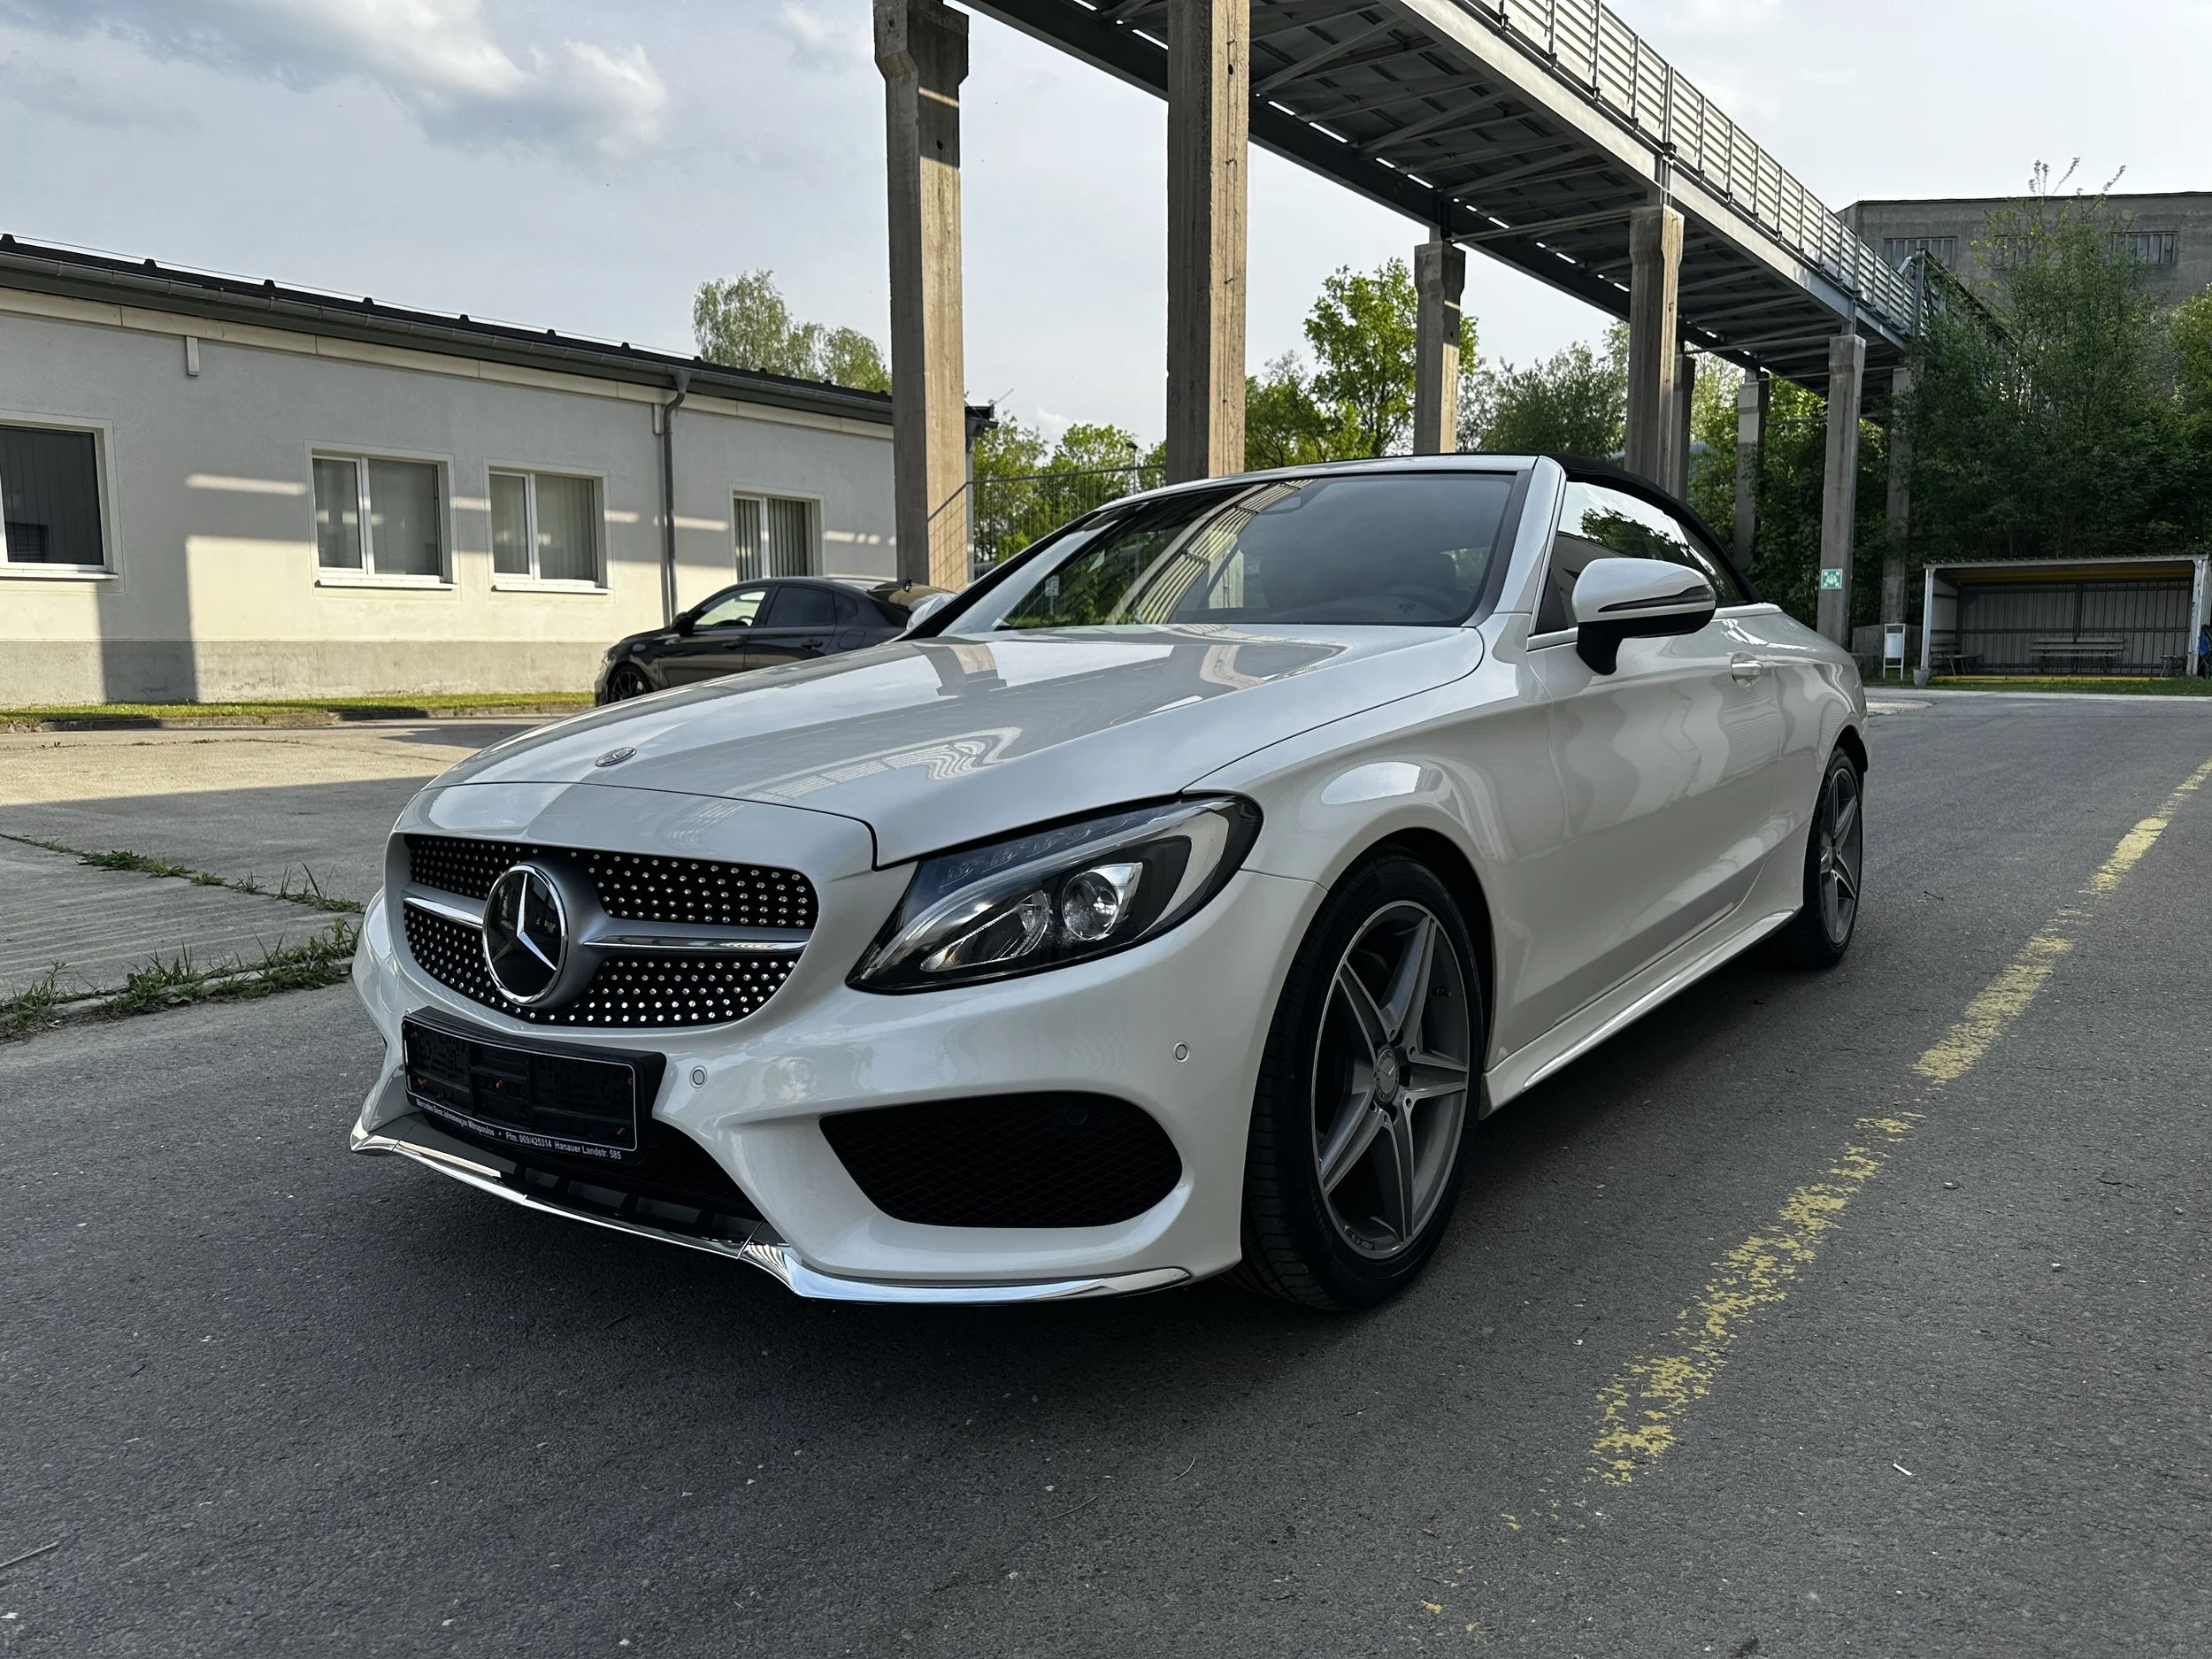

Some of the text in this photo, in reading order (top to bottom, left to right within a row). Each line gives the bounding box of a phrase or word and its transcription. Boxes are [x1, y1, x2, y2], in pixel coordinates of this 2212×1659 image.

[519, 1134, 552, 1148] 069/425314
[555, 1141, 580, 1153] Hanauer
[582, 1145, 608, 1157] Landstr.
[609, 1149, 622, 1160] 585
